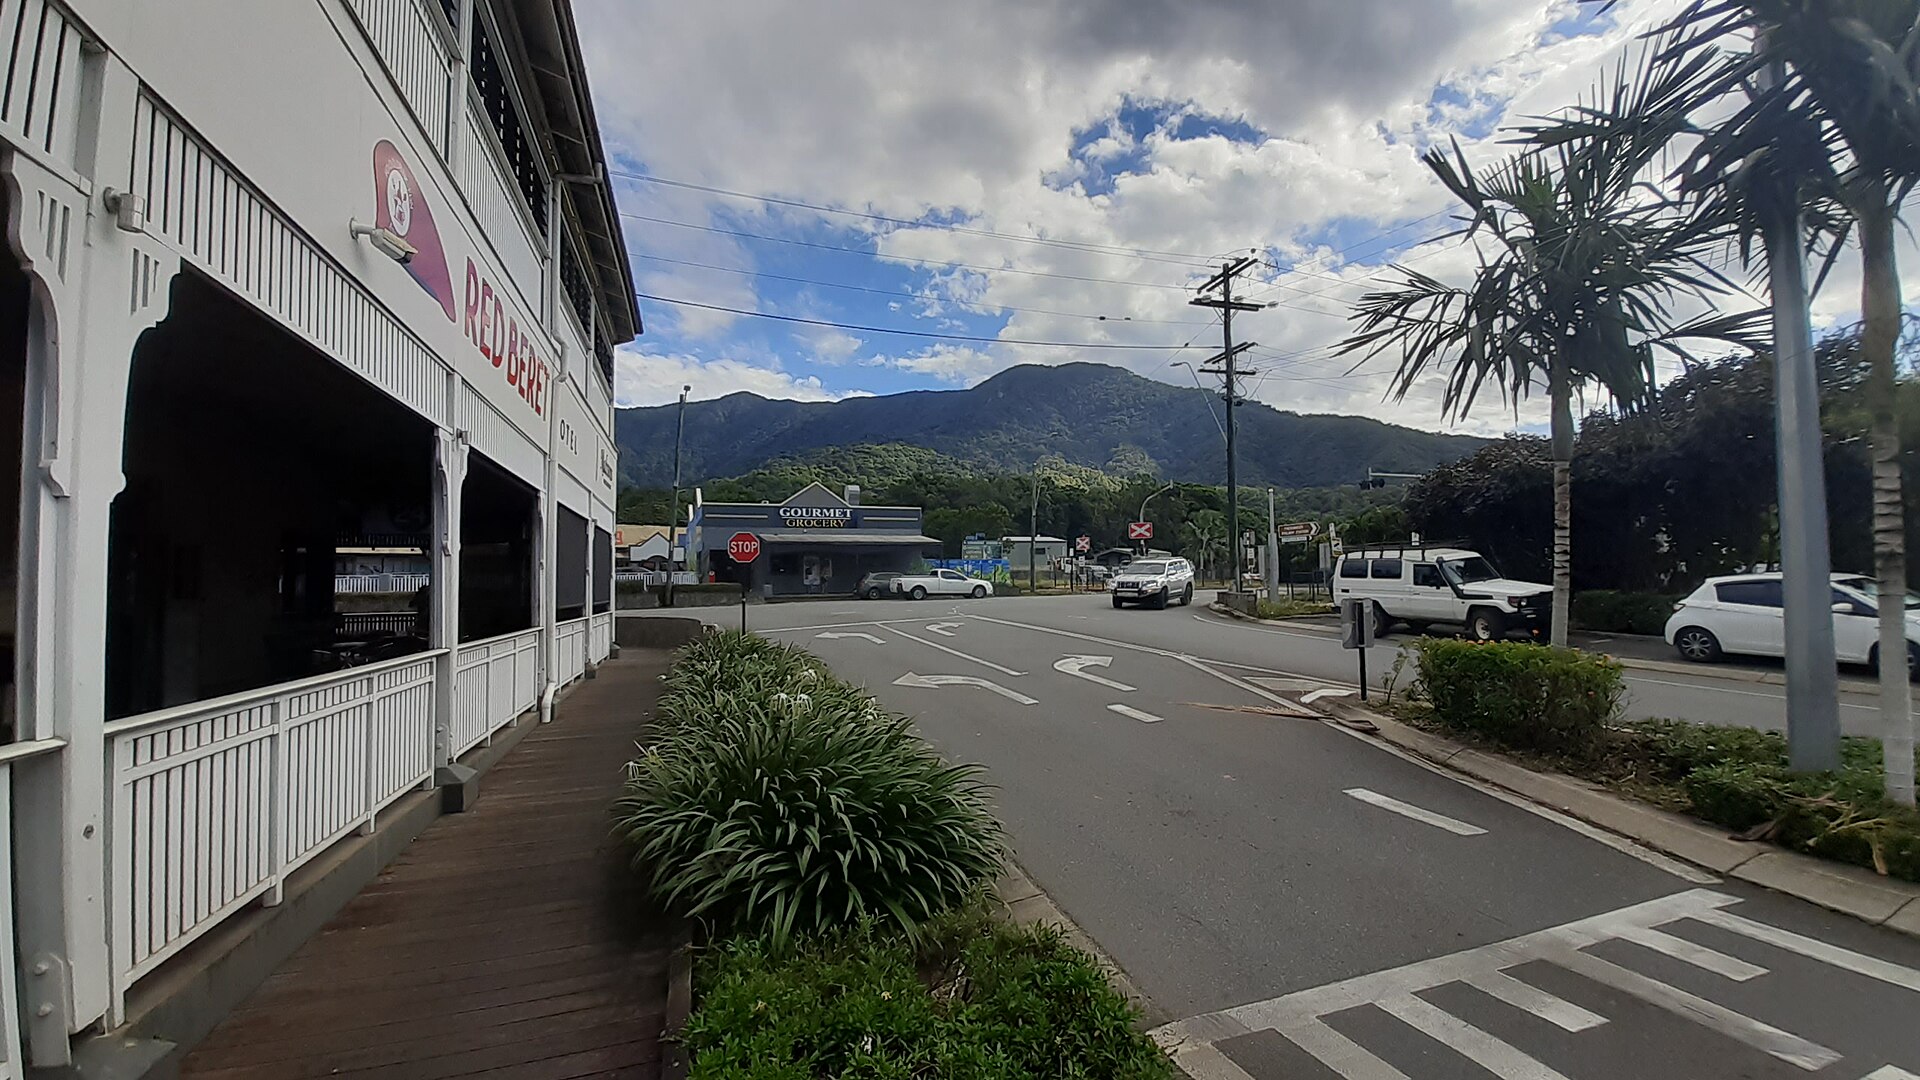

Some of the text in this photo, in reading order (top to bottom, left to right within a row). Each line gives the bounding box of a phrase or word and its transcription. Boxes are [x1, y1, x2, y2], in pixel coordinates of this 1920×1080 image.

[465, 256, 550, 421] RED BERET
[560, 419, 578, 455] OTEL
[779, 507, 853, 518] GOURMET
[786, 519, 846, 528] GROCERY
[730, 541, 758, 553] STOP
